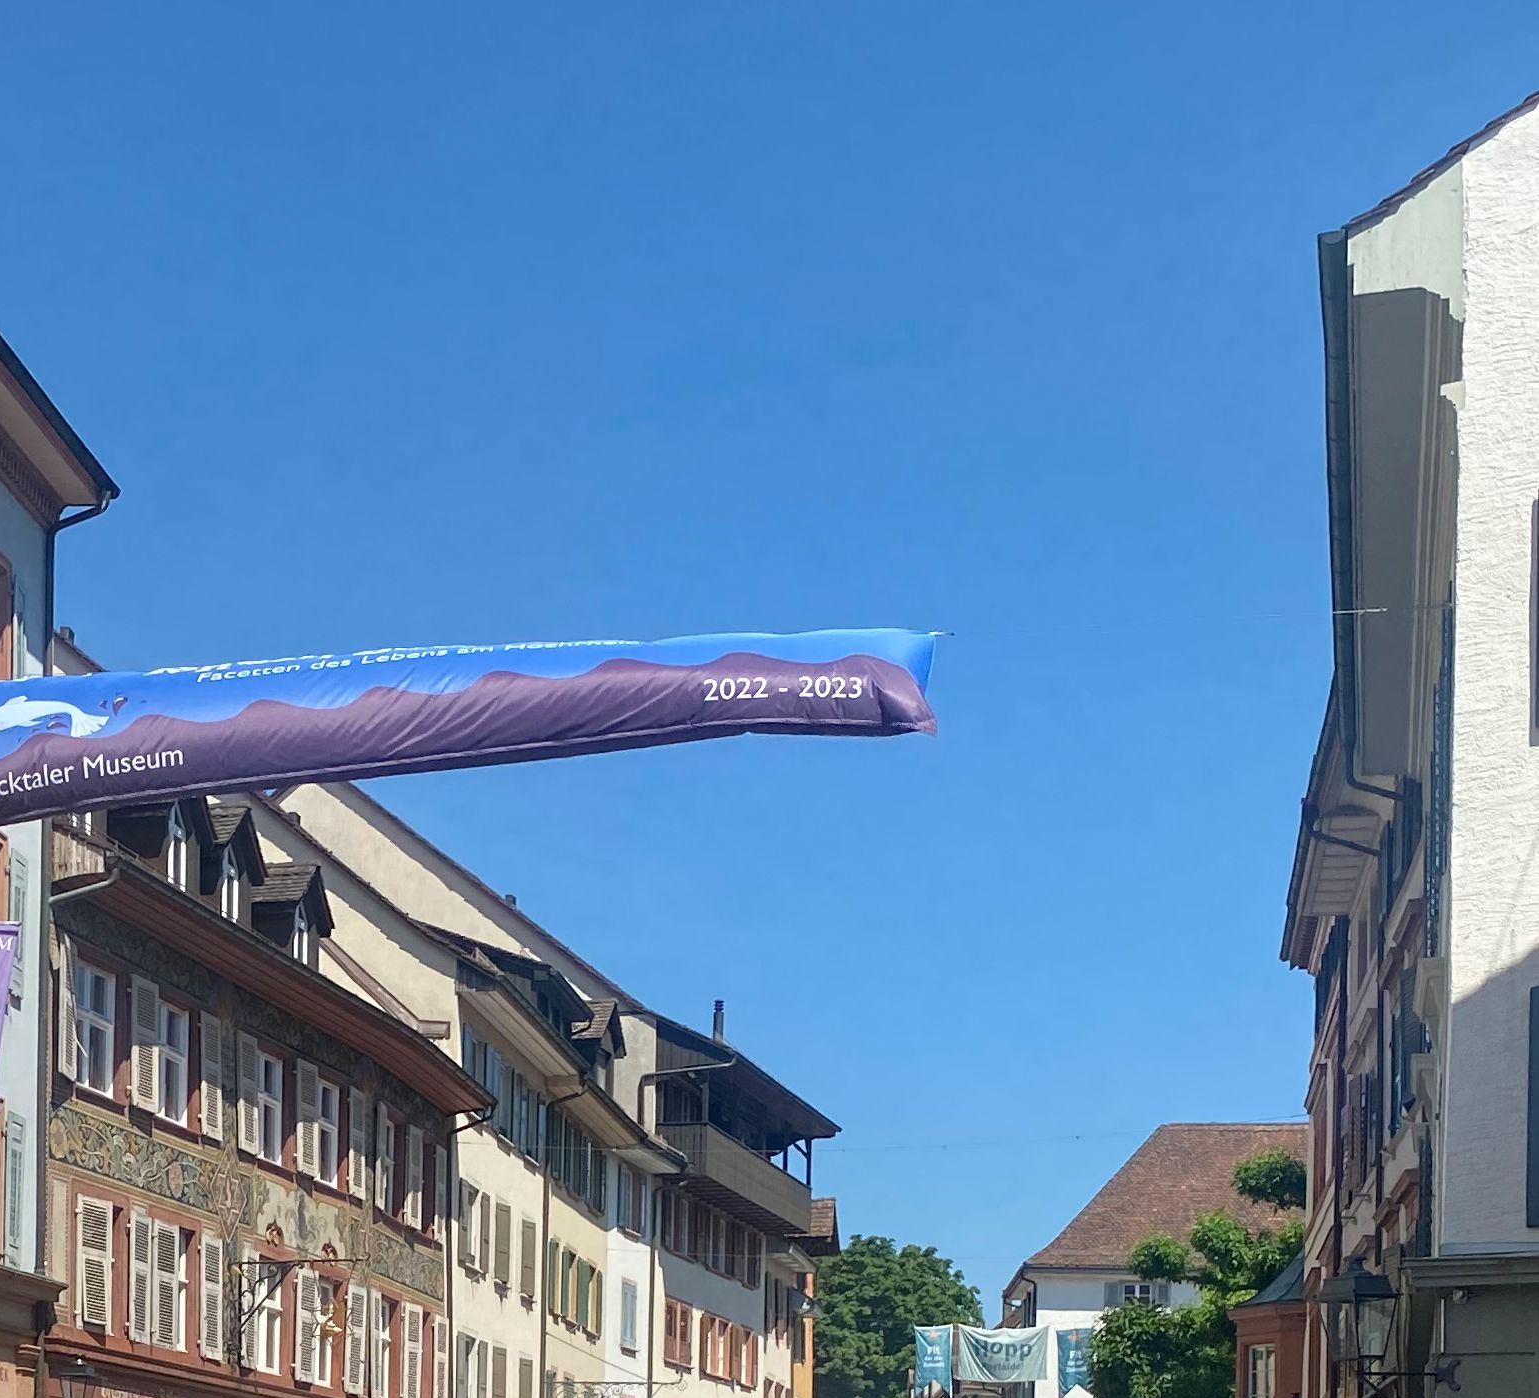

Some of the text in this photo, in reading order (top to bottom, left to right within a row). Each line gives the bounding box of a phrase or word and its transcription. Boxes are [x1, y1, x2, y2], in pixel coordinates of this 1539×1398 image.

[196, 664, 301, 683] Facetten
[309, 659, 352, 670] des
[361, 649, 449, 665] Lebens
[703, 676, 769, 702] 2022
[798, 675, 863, 699] 2023
[82, 748, 184, 780] Museum
